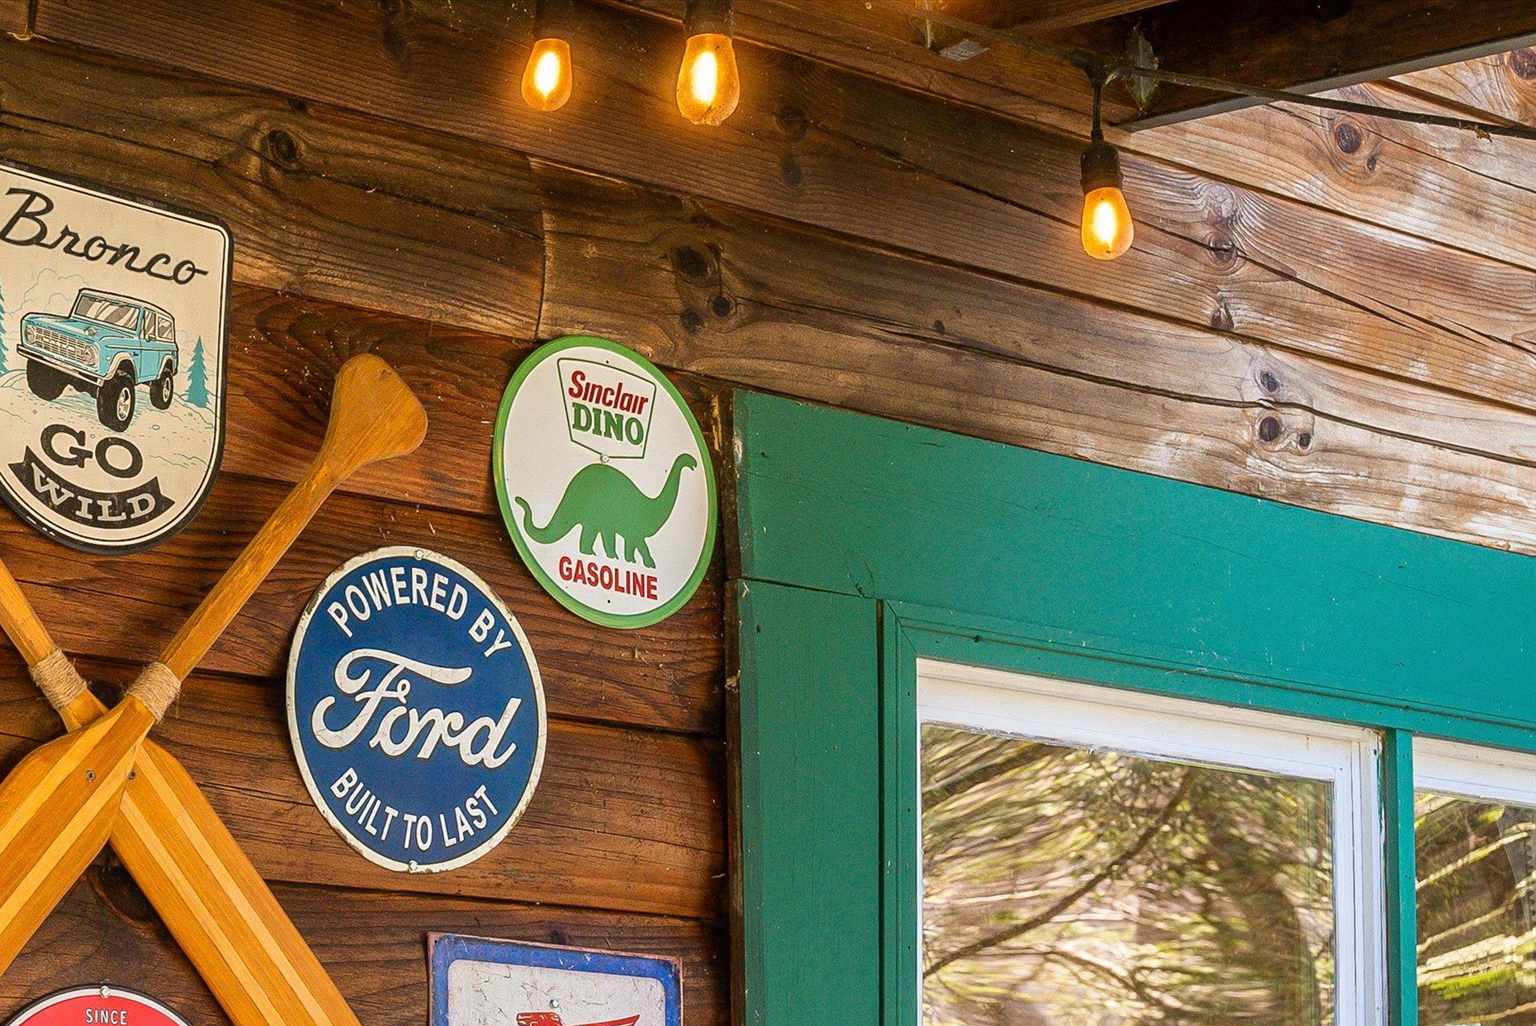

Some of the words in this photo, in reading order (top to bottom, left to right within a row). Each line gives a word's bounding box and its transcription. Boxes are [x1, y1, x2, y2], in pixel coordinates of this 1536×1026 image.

[568, 370, 648, 415] Sinclair
[572, 402, 644, 445] DINO
[40, 424, 143, 479] GO
[30, 462, 156, 521] WILD
[559, 556, 658, 600] GASOLINE
[327, 567, 468, 638] POWERED
[468, 611, 512, 657] BY
[311, 648, 521, 769] Ford
[330, 767, 398, 841] BUILT
[403, 814, 433, 851] TO
[439, 784, 498, 847] LAST
[85, 1008, 128, 1026] SINCE
